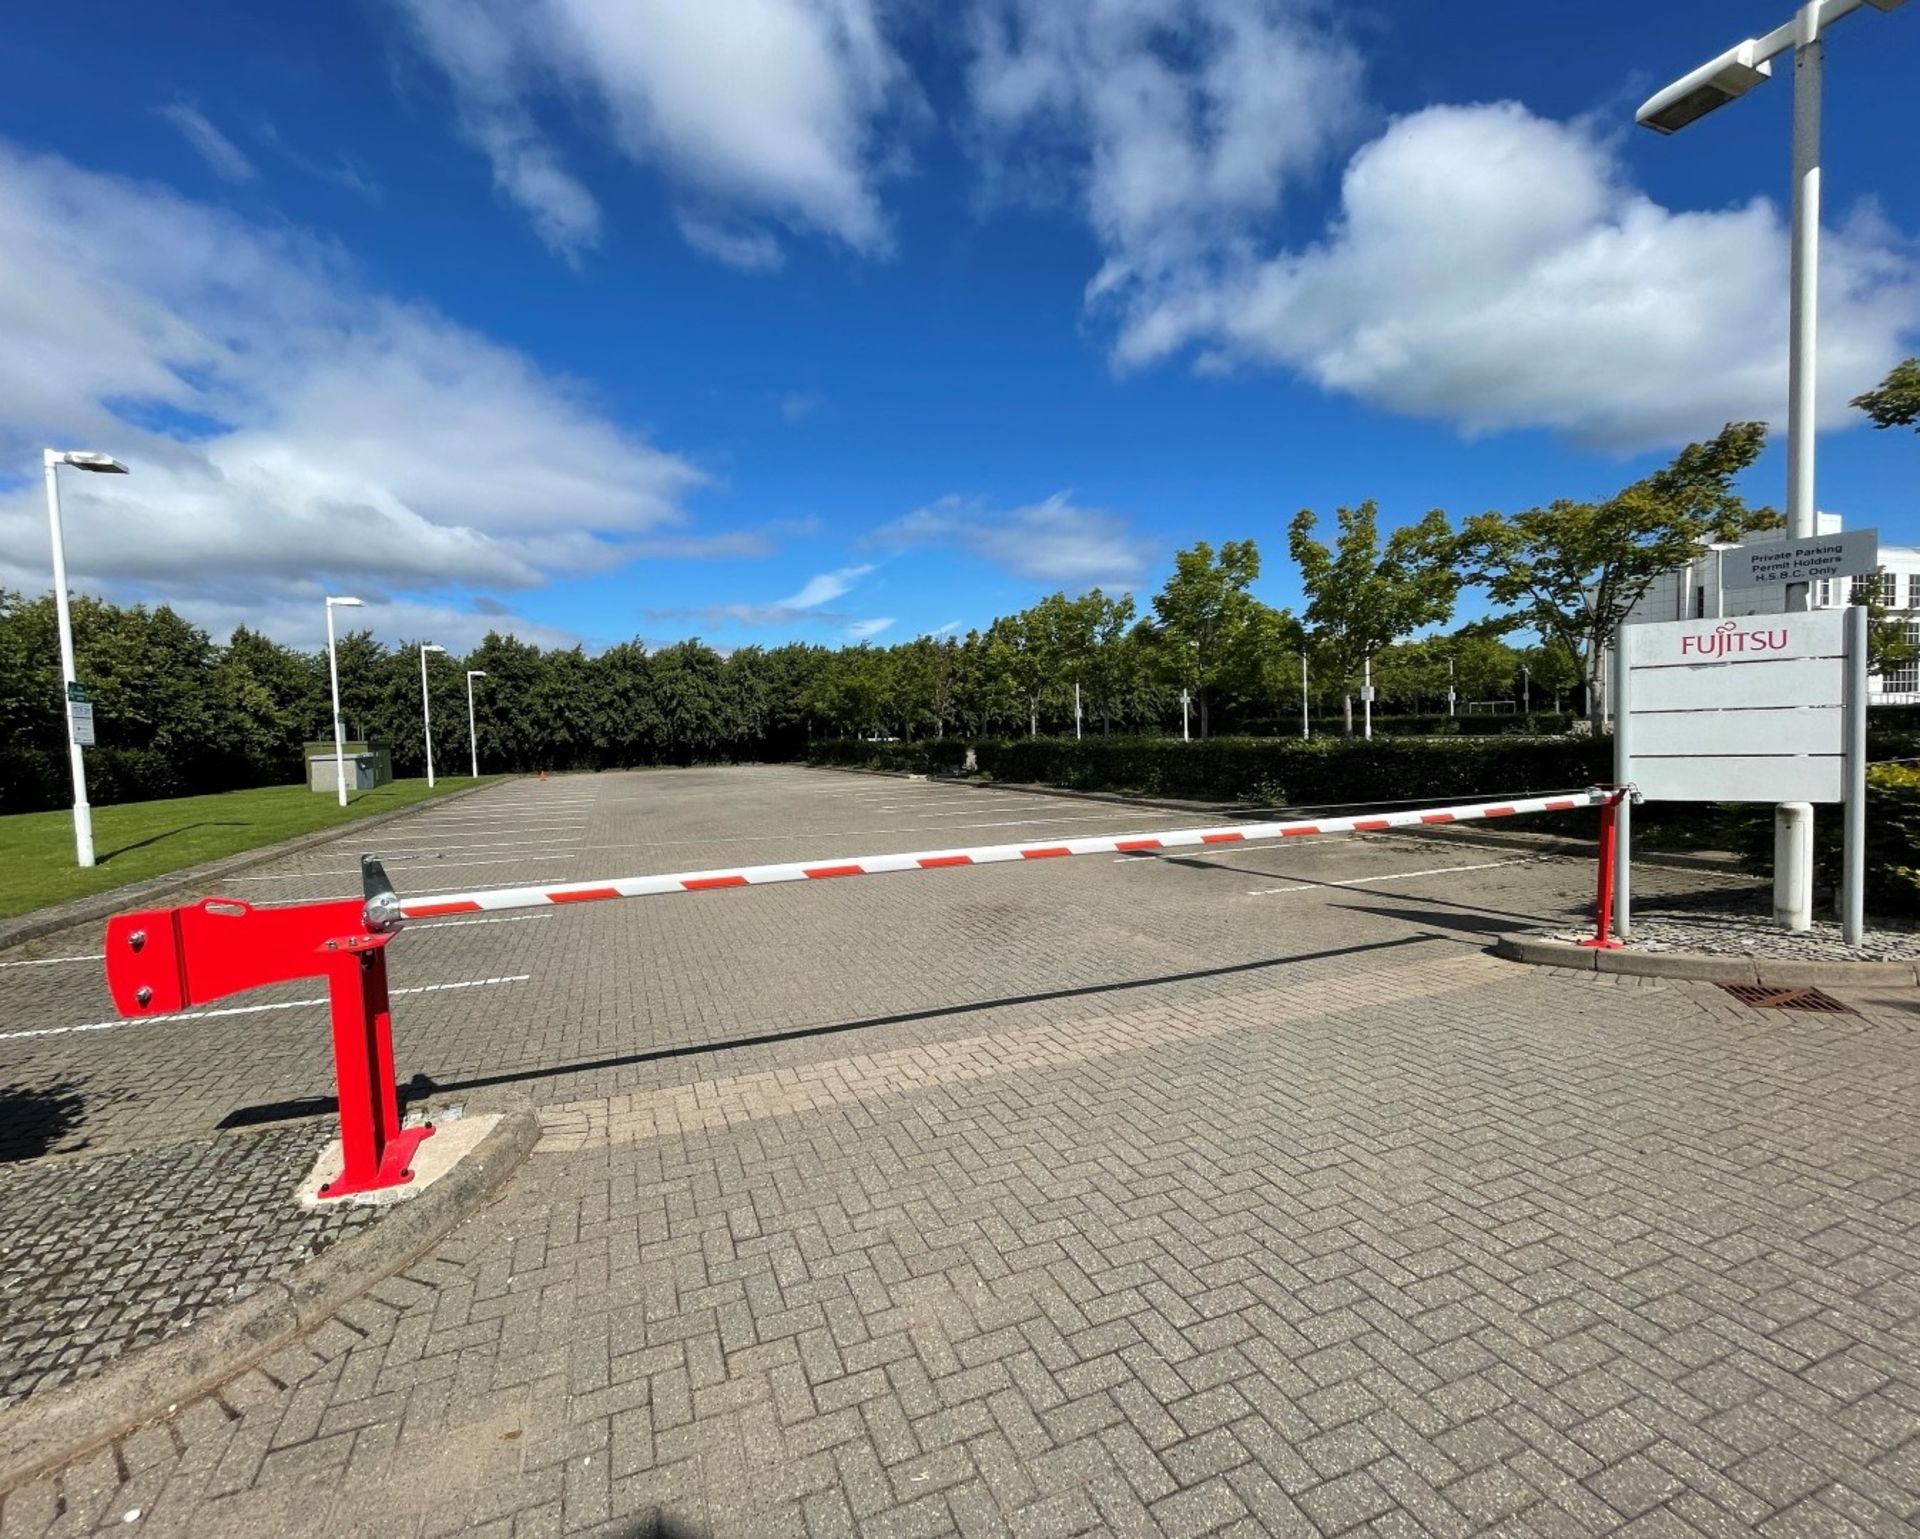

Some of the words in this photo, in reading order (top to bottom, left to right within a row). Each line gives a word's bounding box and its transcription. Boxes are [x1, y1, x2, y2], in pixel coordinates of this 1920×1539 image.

[1751, 552, 1792, 563] Private
[1795, 545, 1843, 557] Parking
[1752, 562, 1790, 573] Permit
[1794, 555, 1842, 568] Holders
[1809, 566, 1838, 576] Only
[1681, 621, 1788, 658] FUJITSU
